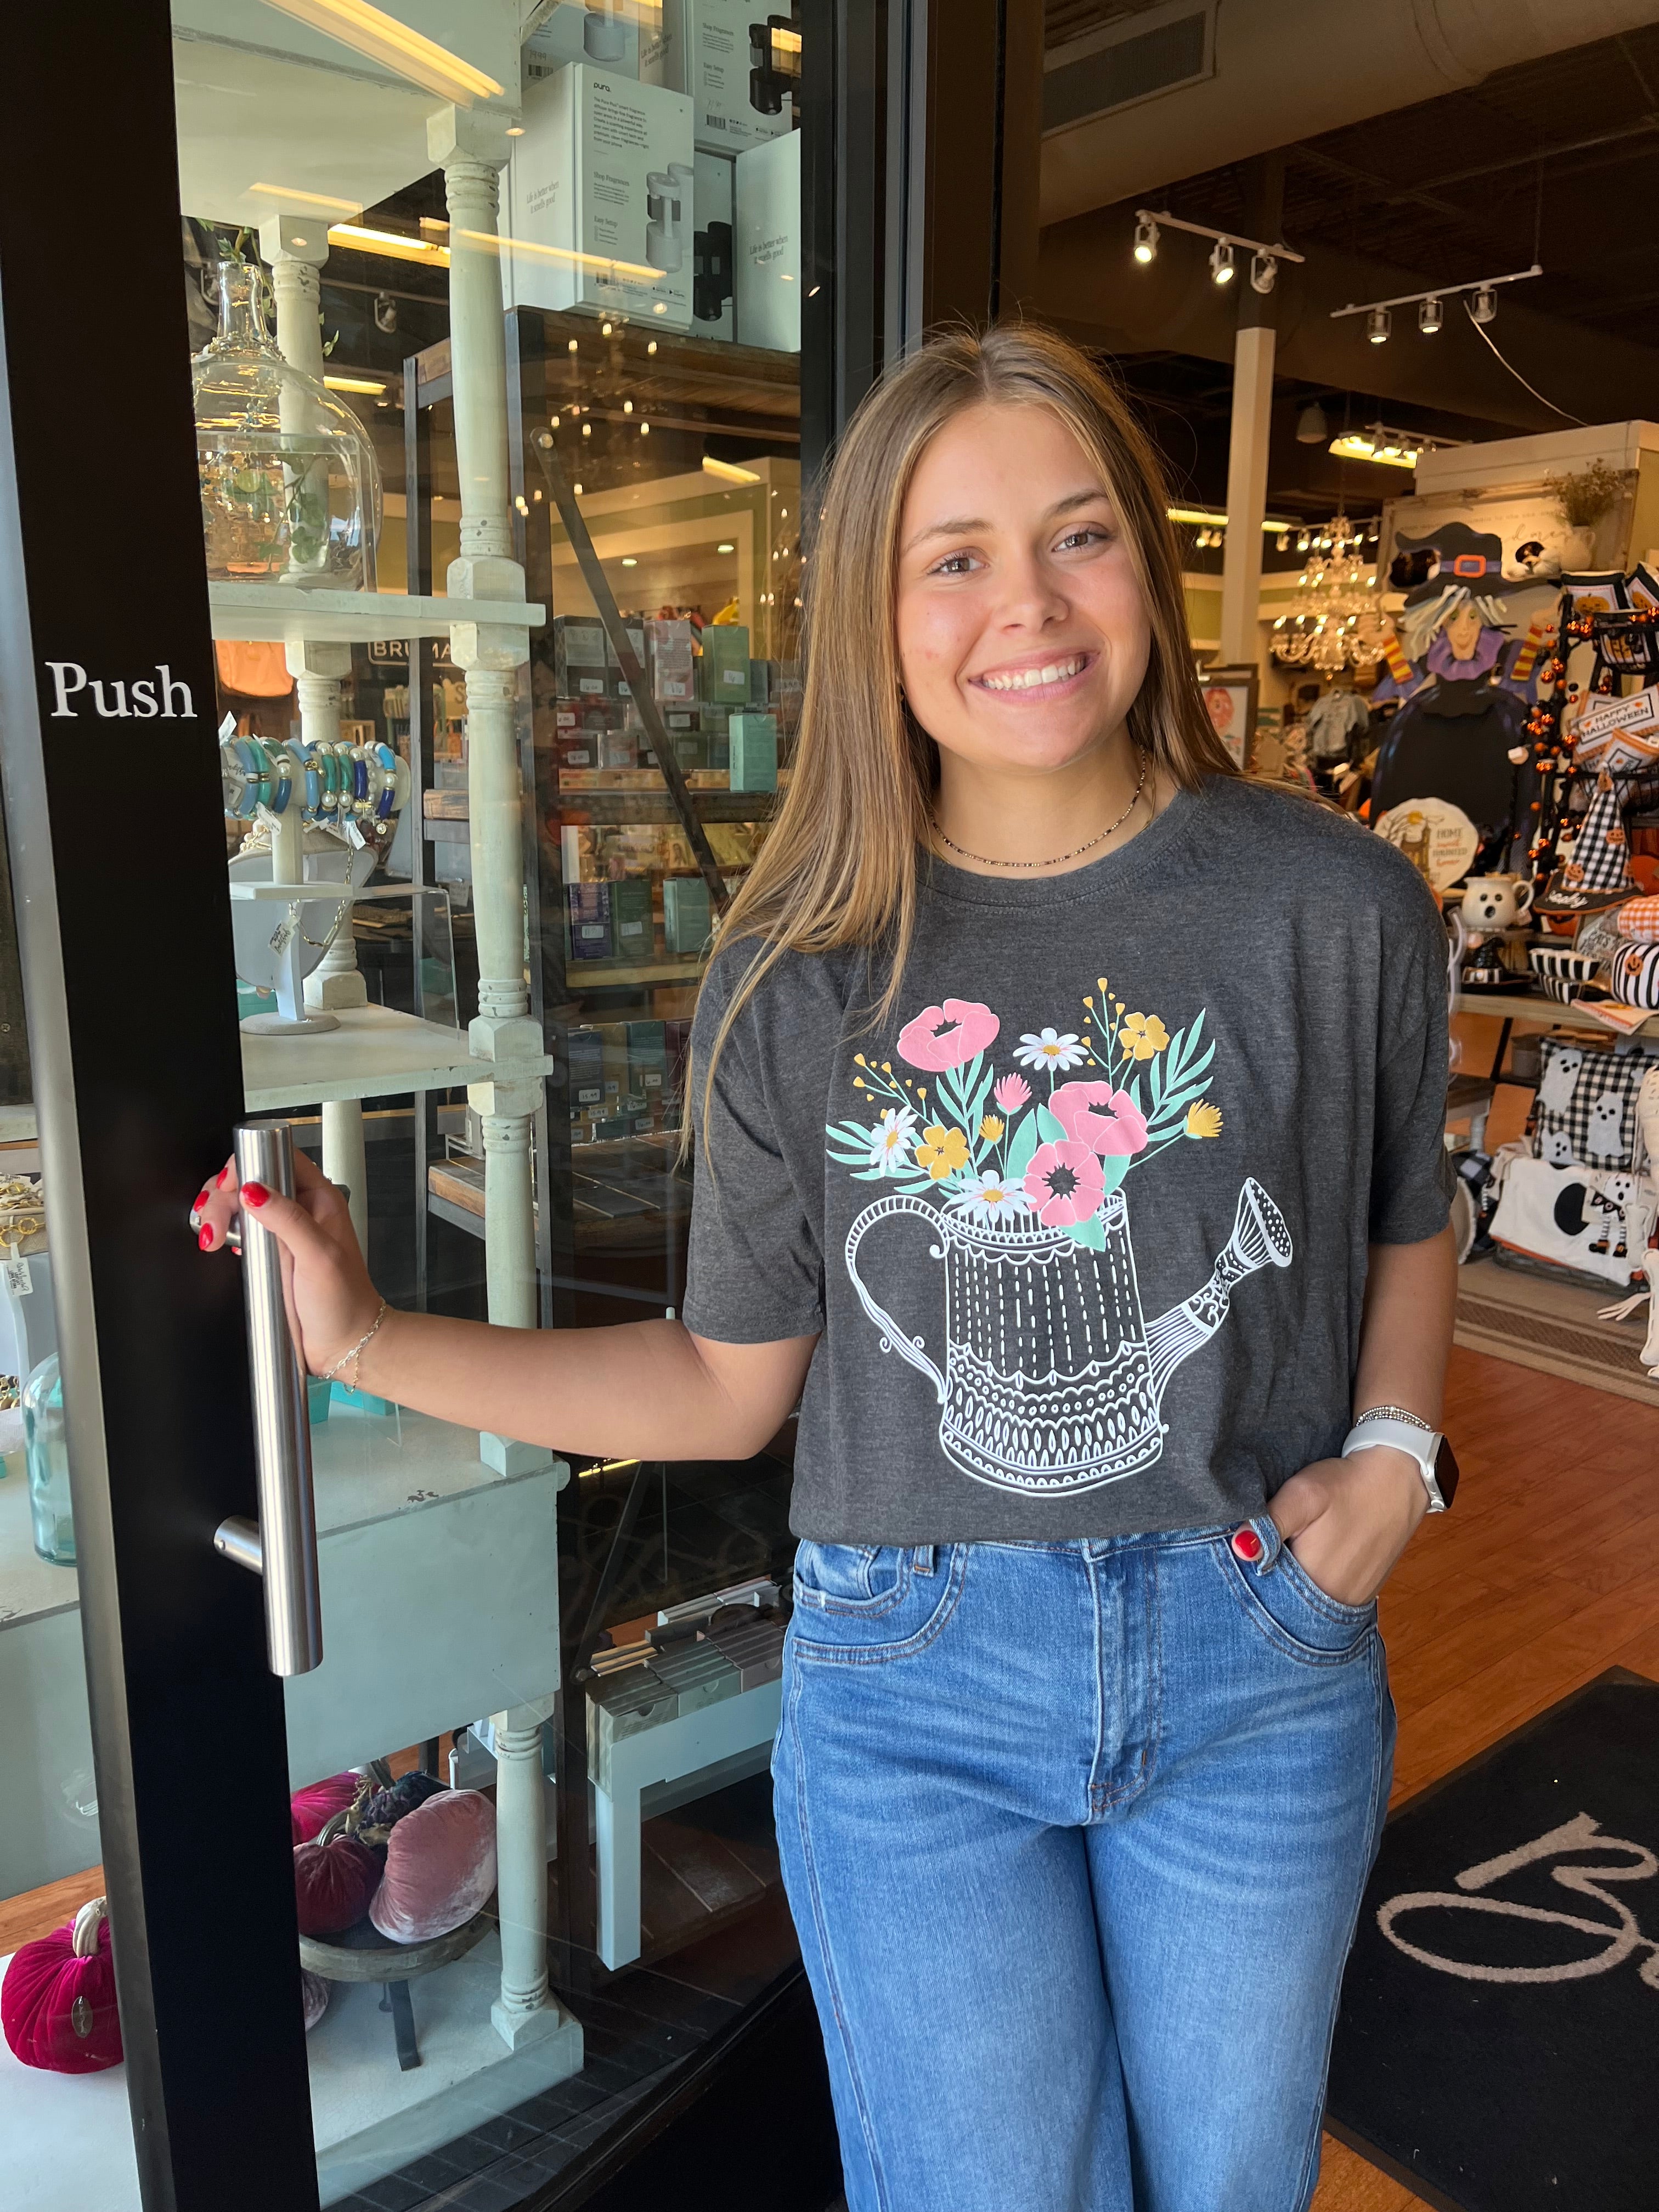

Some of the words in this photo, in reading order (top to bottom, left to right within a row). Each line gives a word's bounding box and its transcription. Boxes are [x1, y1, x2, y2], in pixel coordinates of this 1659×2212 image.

[44, 661, 198, 718] Push
[1582, 707, 1649, 737] HALLOWEEN
[1595, 704, 1630, 723] HAPPY
